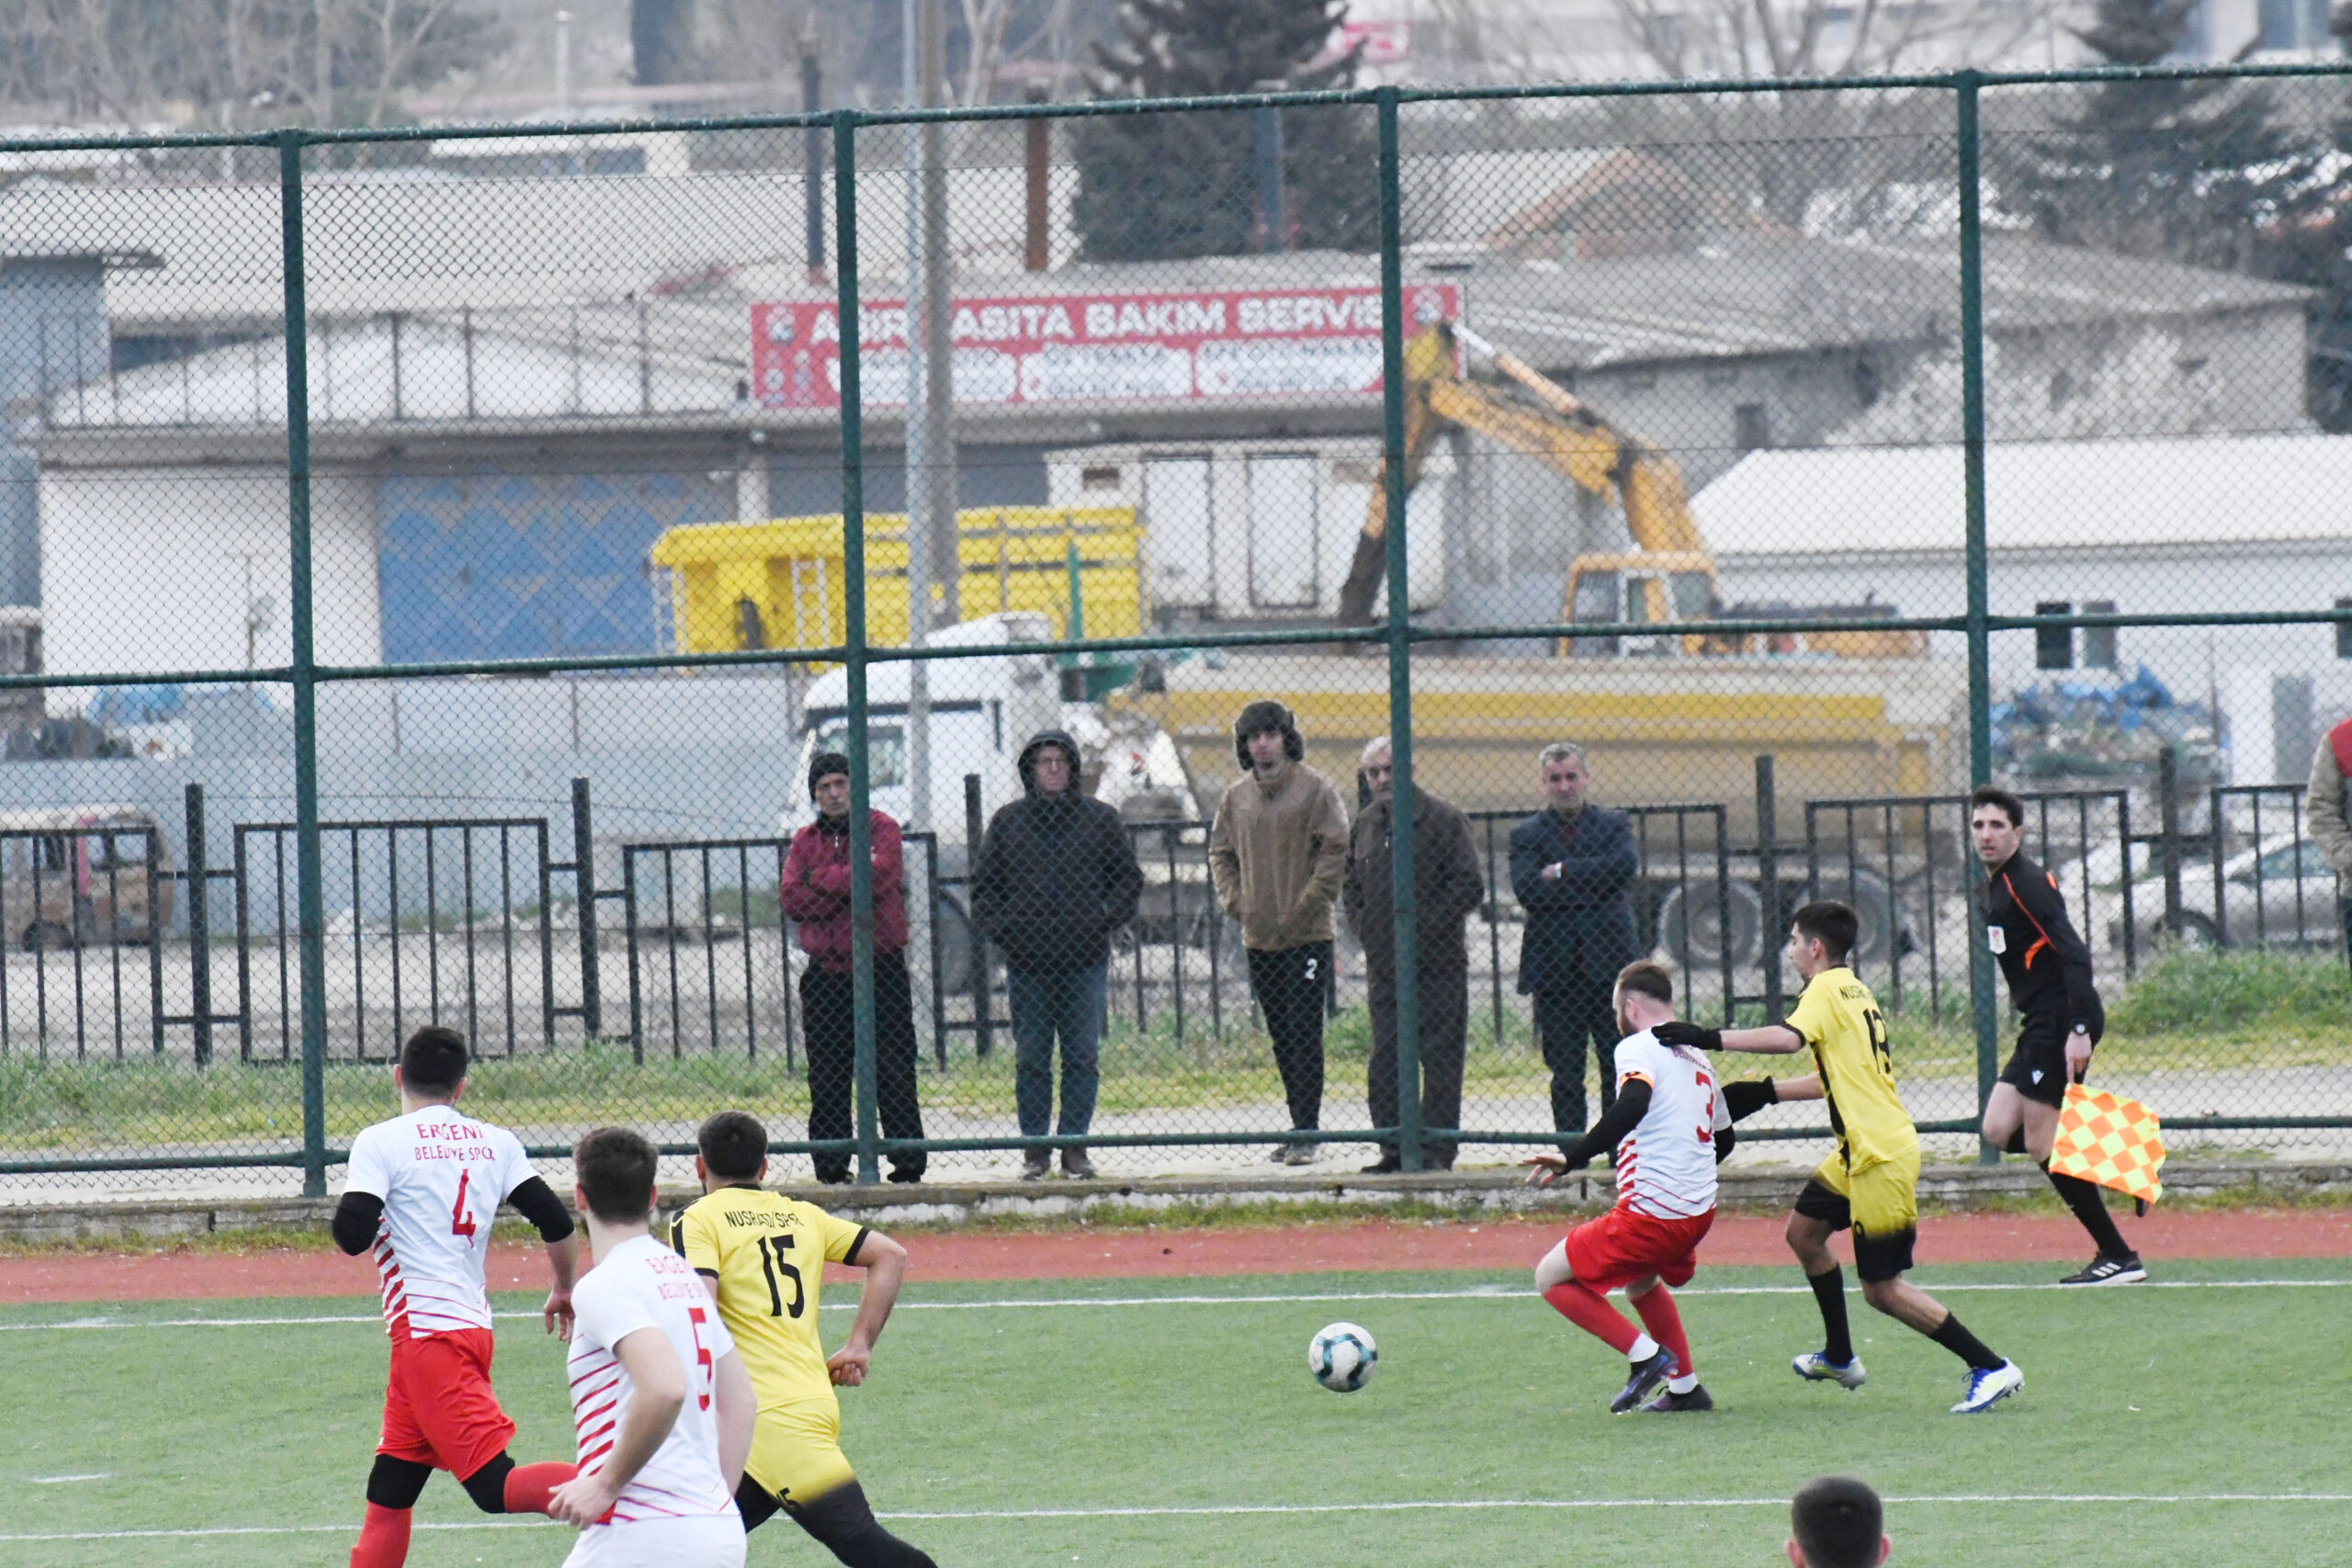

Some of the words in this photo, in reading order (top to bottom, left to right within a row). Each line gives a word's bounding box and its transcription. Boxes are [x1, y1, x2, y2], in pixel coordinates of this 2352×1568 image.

[930, 304, 1074, 342] ASITA
[1084, 299, 1226, 339] BAKIM
[1305, 958, 1317, 979] 2
[1696, 1070, 1714, 1143] 3
[452, 1168, 477, 1249] 4
[757, 1235, 805, 1319] 15
[687, 1307, 712, 1412] 5
